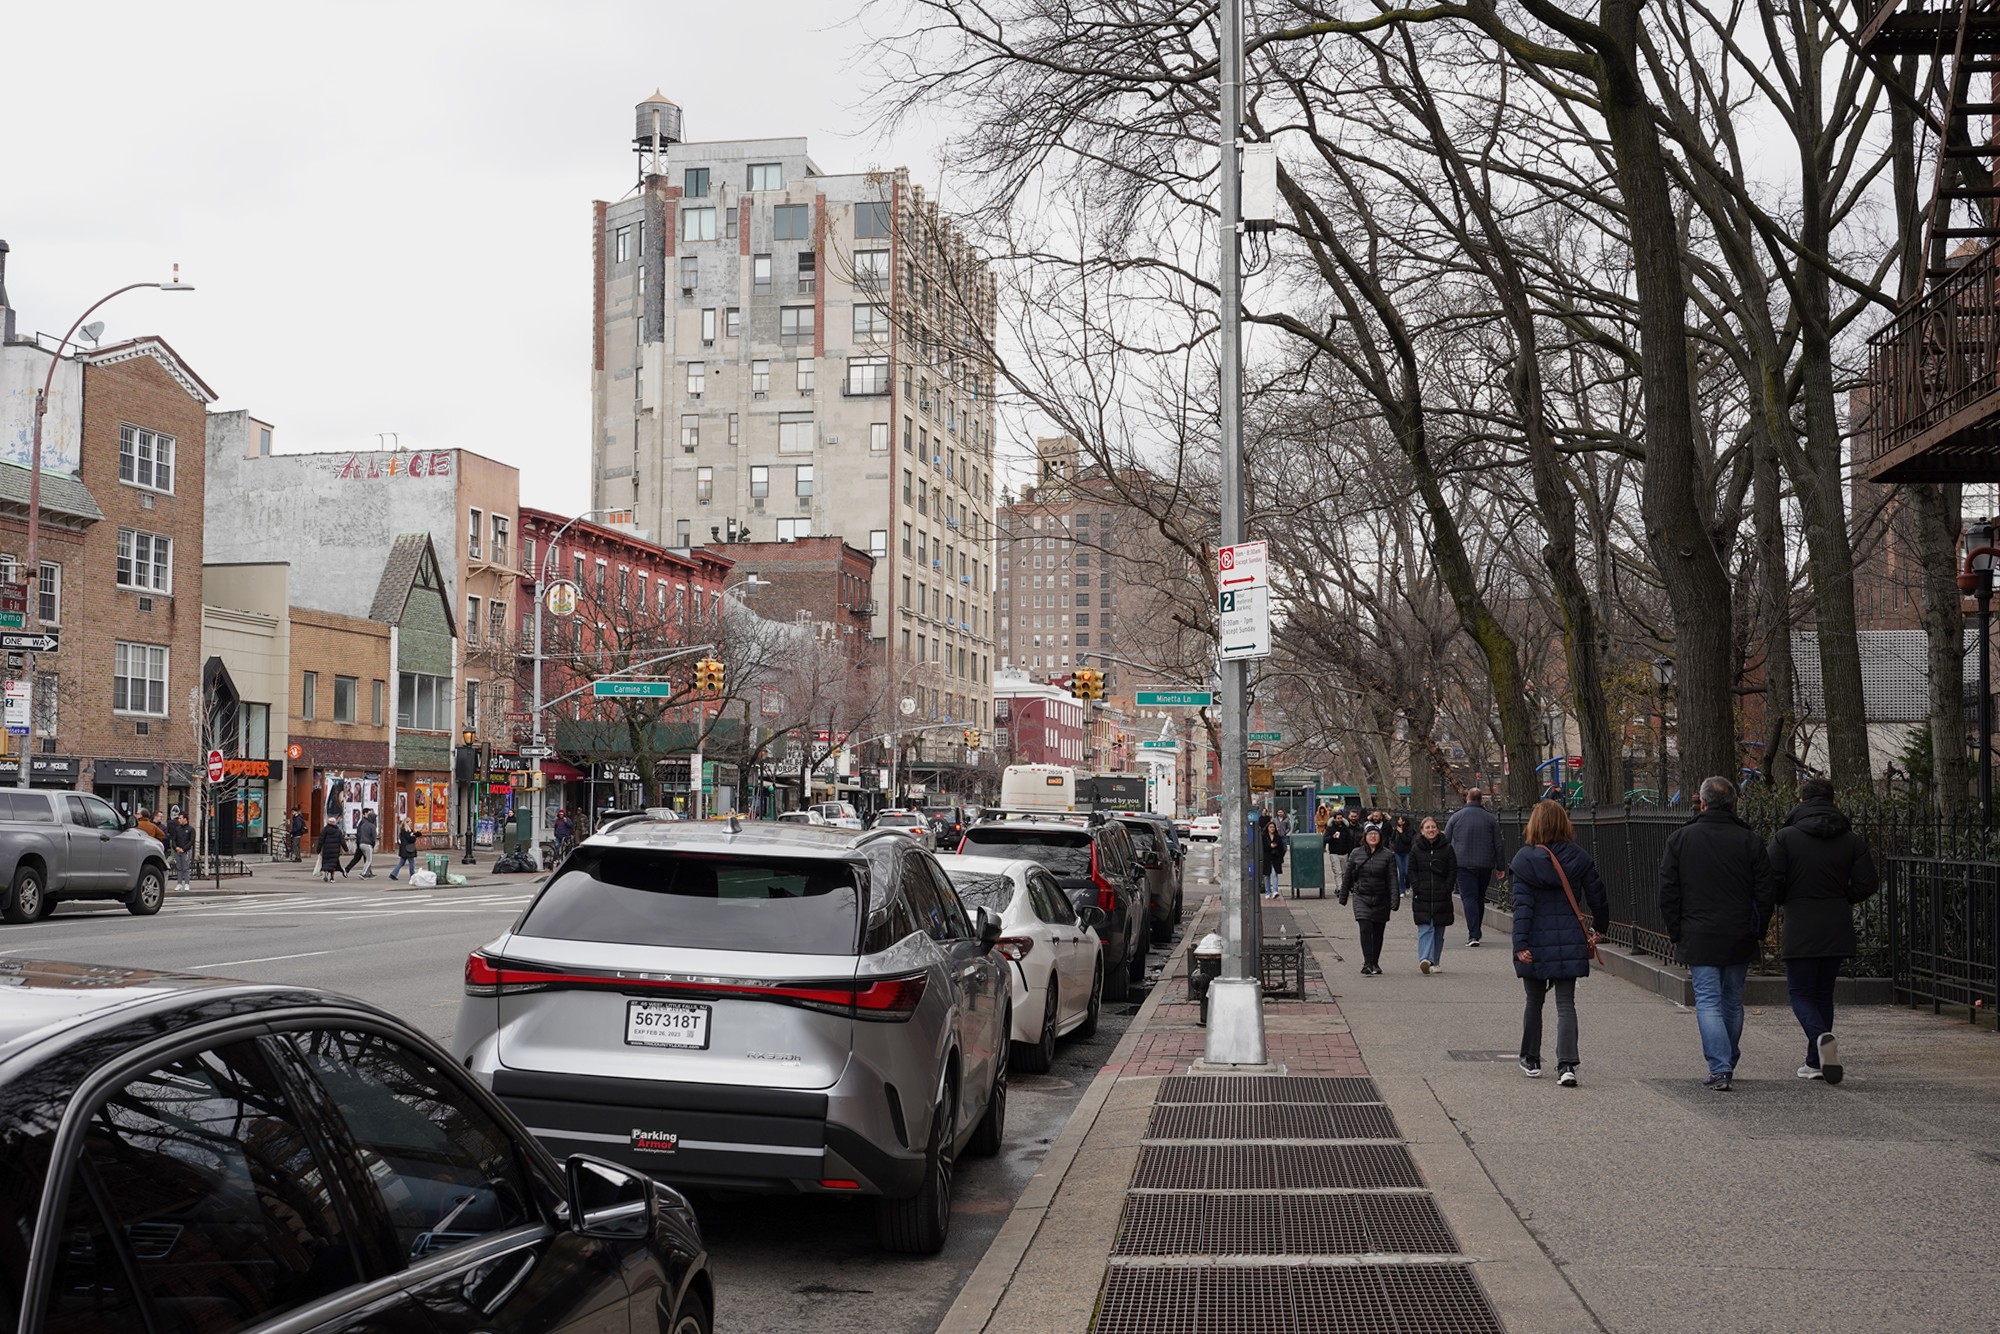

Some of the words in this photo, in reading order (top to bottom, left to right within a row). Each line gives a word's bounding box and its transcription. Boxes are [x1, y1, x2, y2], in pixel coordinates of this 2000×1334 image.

[1223, 593, 1232, 611] 2
[1223, 619, 1240, 627] 8:30am
[1243, 617, 1254, 625] 7pm
[1223, 627, 1238, 635] Except
[1239, 626, 1256, 634] Sunday
[4, 636, 22, 645] ONE
[32, 638, 51, 647] WAY
[613, 685, 641, 693] Carmine
[642, 686, 651, 694] St
[1156, 695, 1181, 703] Minetta
[1183, 695, 1192, 703] Ln
[499, 755, 510, 772] Pop
[510, 761, 520, 770] NYC
[1118, 797, 1127, 805] by
[616, 971, 721, 984] LEXUS
[635, 1012, 701, 1029] 567318T
[631, 1128, 677, 1143] Parking
[637, 1138, 673, 1149] Armor
